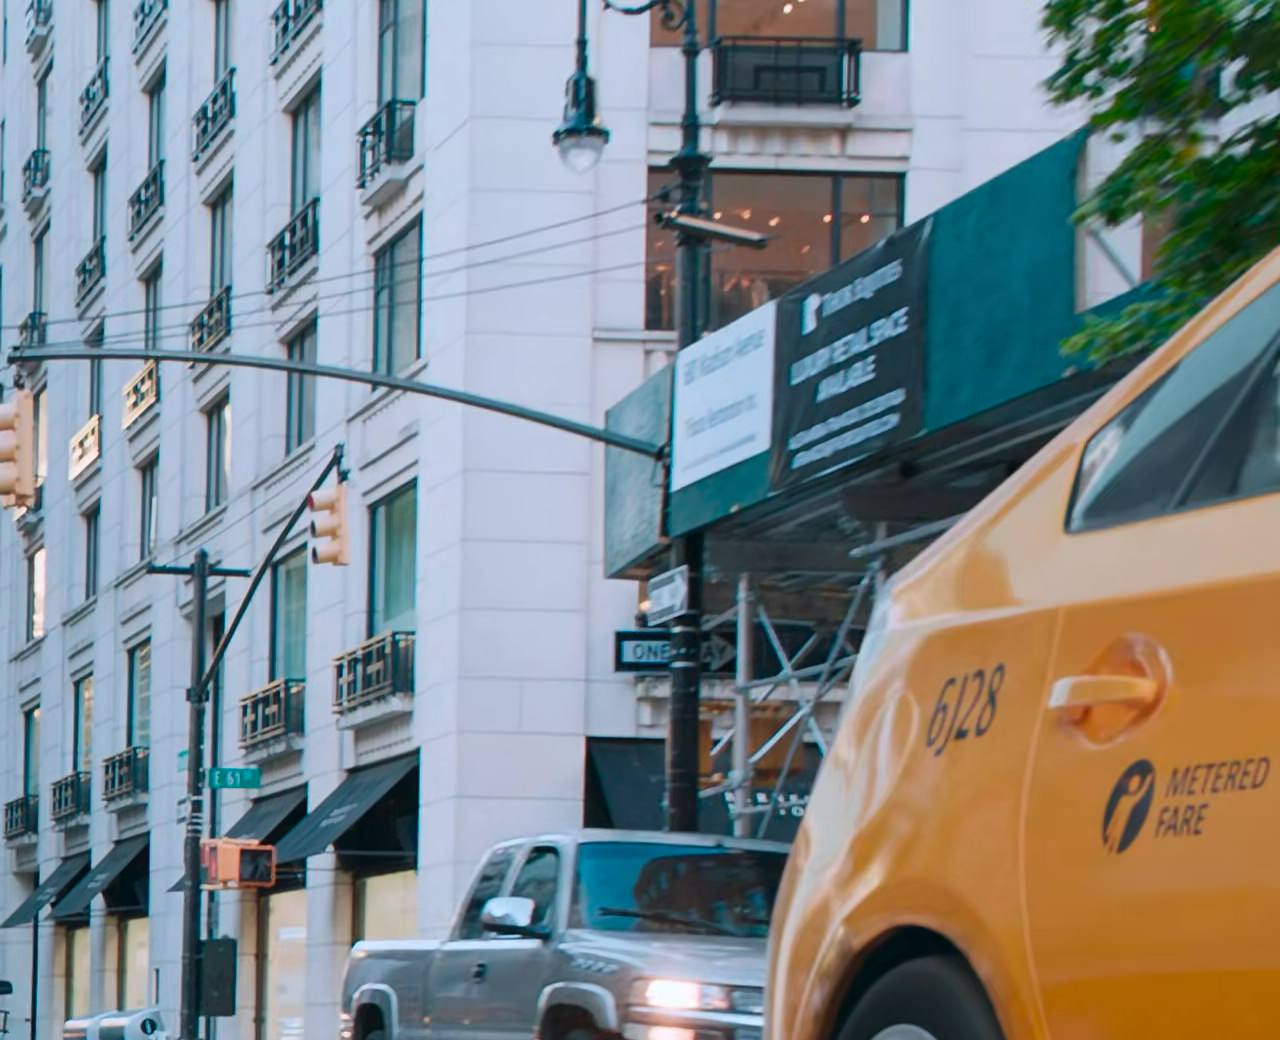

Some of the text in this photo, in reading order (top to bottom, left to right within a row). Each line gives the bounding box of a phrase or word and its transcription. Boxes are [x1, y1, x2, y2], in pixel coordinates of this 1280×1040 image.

[633, 643, 671, 660] ONE
[214, 770, 222, 786] E
[226, 770, 241, 786] 61
[1165, 756, 1271, 799] METERED
[1154, 803, 1209, 839] FARE
